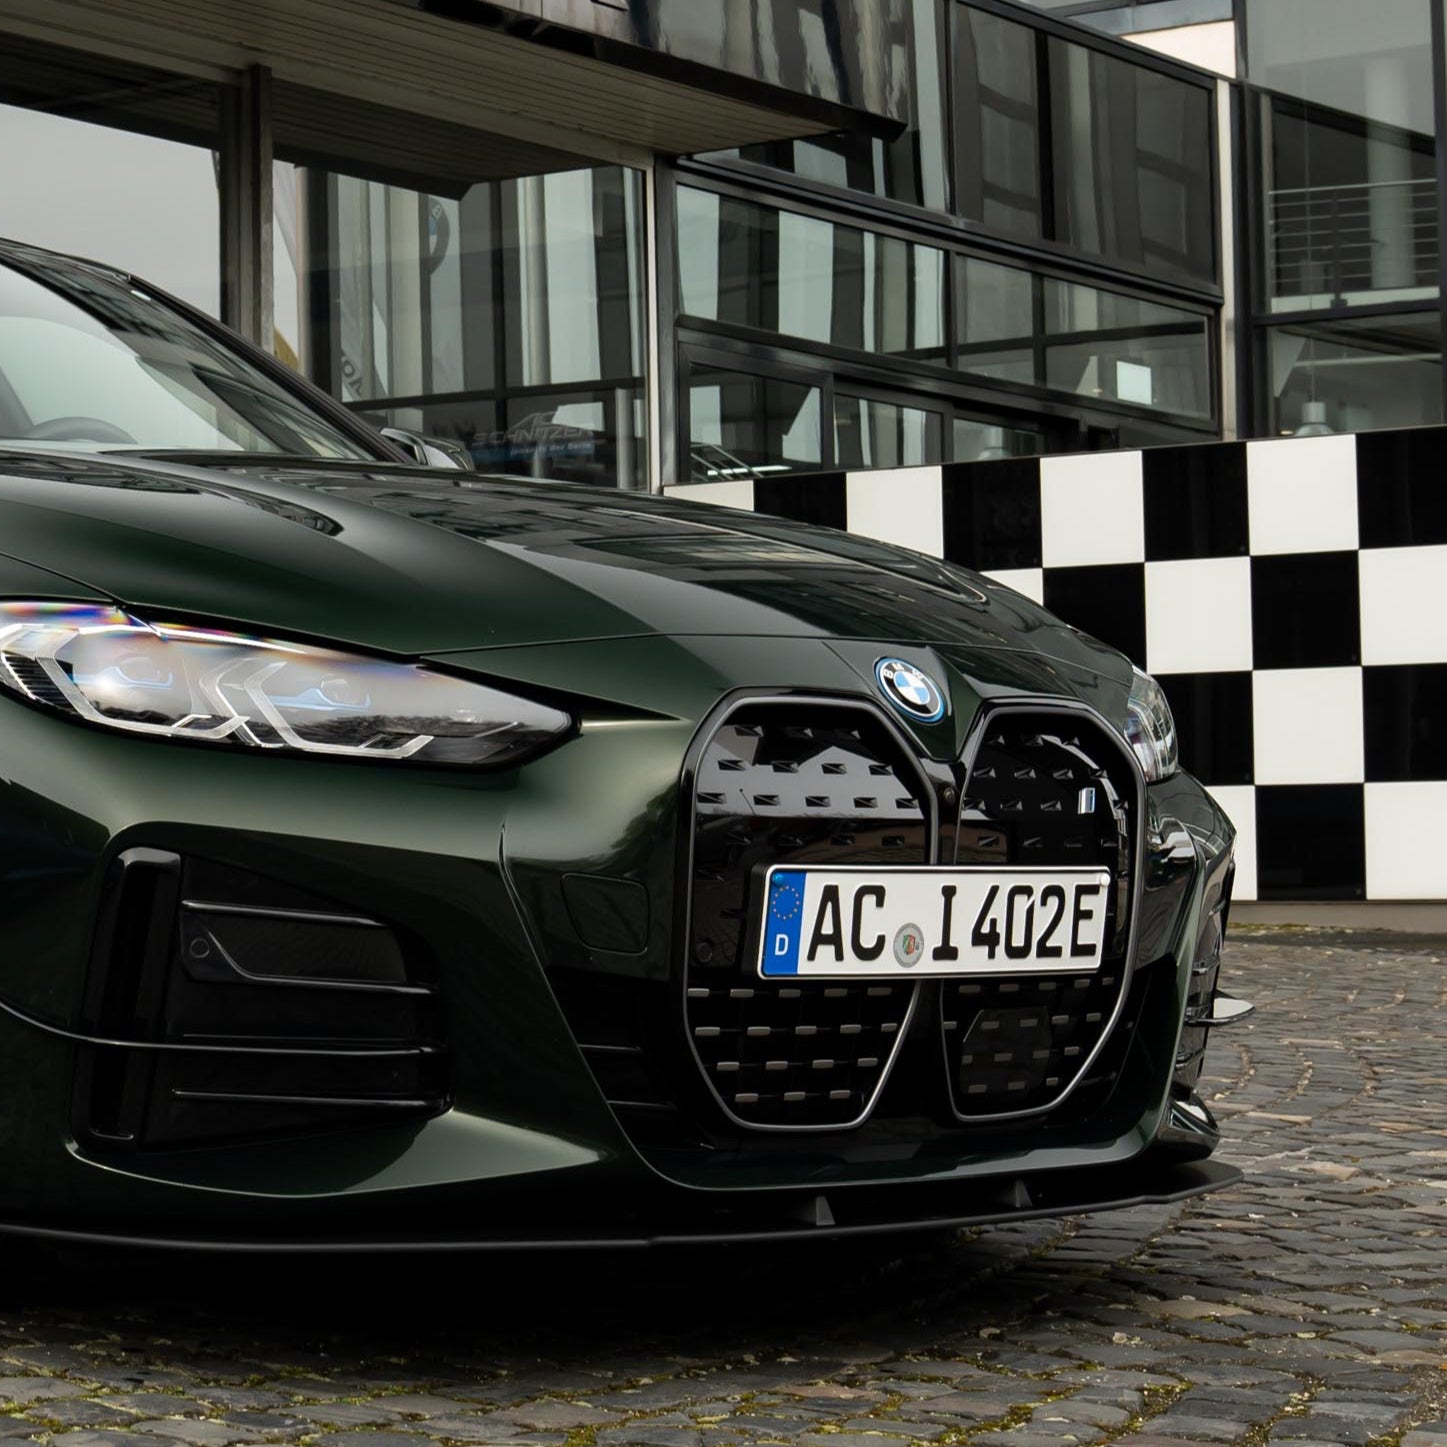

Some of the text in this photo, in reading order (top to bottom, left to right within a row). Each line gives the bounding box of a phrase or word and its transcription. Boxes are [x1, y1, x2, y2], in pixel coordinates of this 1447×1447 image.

[882, 662, 925, 680] BMW
[806, 883, 886, 962] AC
[774, 933, 789, 956] D
